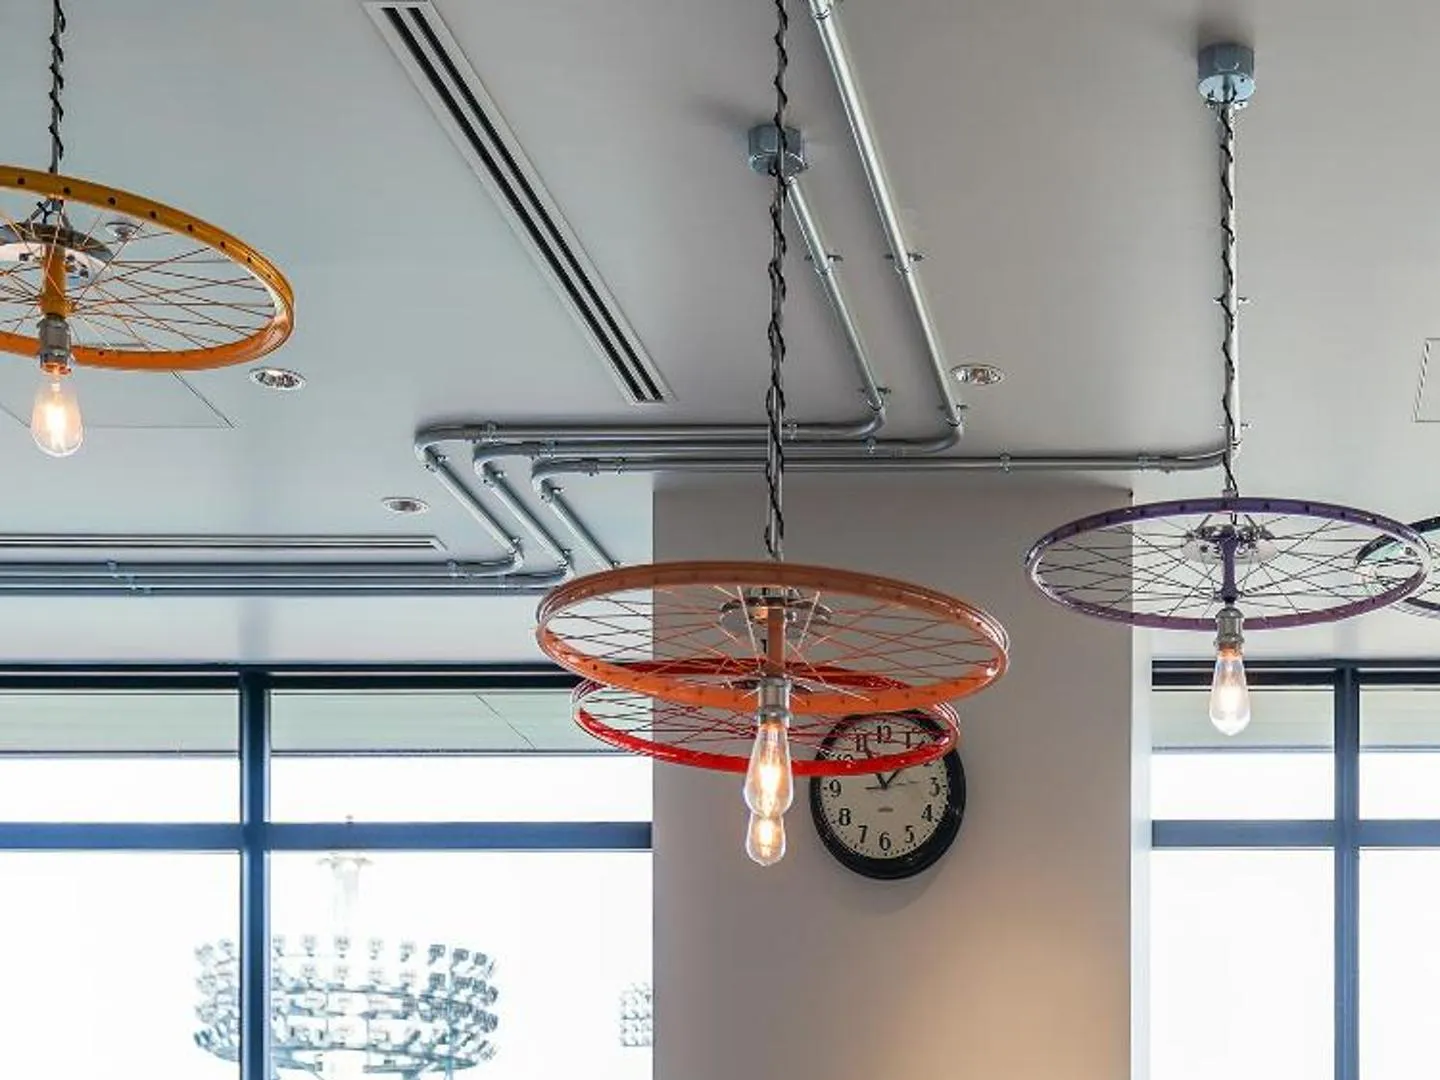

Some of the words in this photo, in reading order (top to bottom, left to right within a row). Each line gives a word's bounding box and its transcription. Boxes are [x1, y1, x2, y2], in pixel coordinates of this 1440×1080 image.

[829, 779, 841, 797] 9
[929, 777, 940, 796] 3
[838, 808, 850, 825] 8
[921, 804, 932, 822] 4
[858, 825, 868, 843] 7
[879, 832, 891, 850] 6
[904, 825, 914, 843] 5
